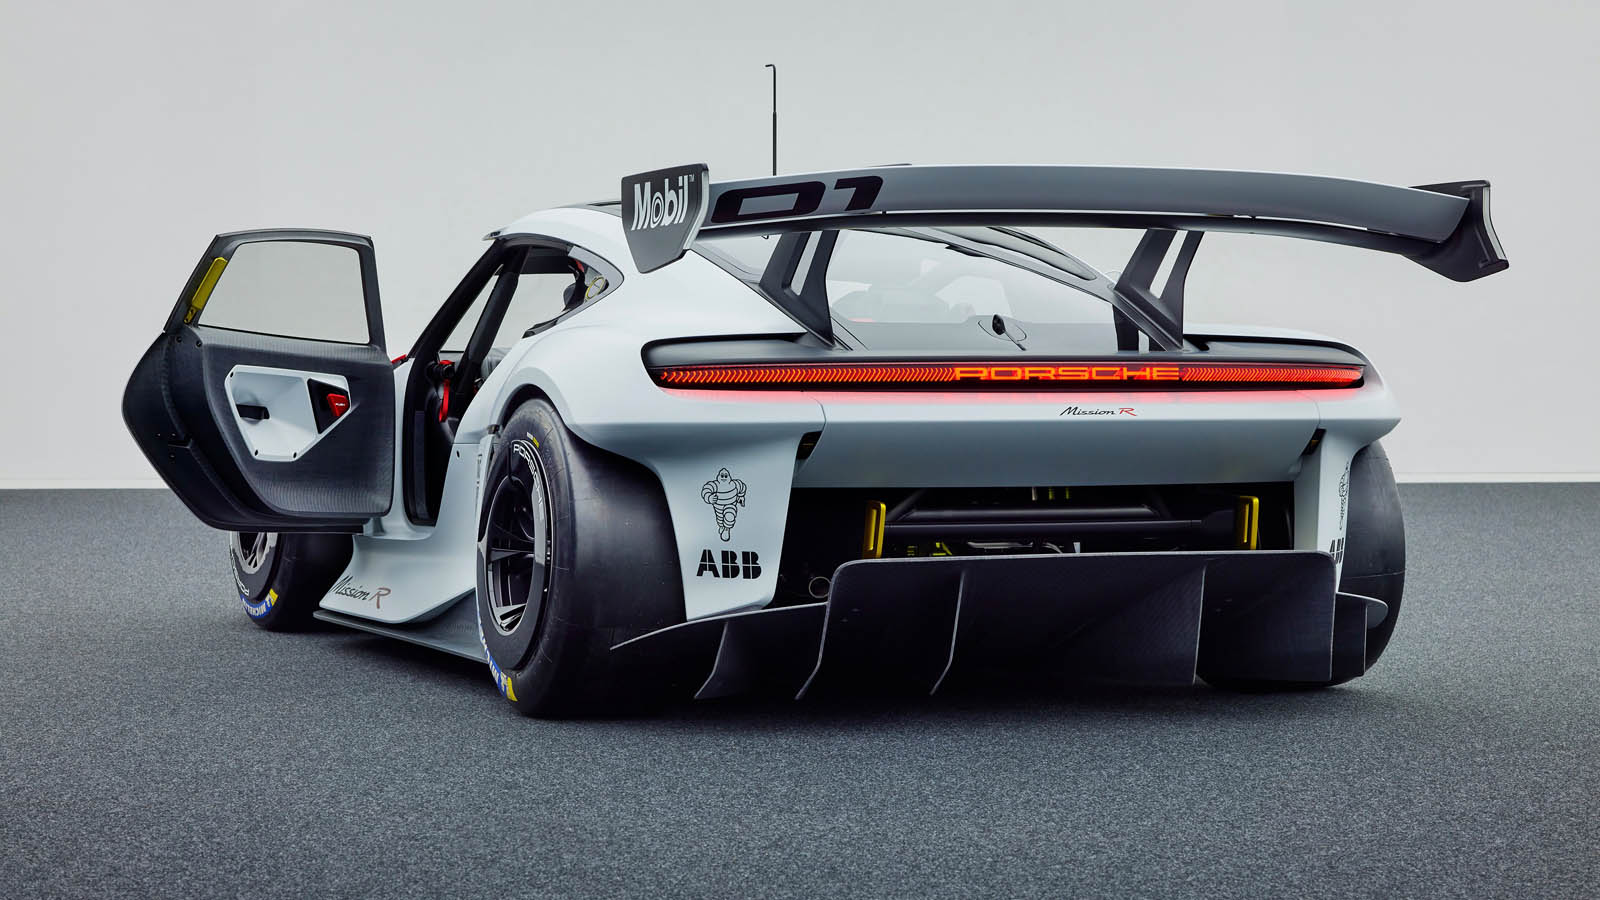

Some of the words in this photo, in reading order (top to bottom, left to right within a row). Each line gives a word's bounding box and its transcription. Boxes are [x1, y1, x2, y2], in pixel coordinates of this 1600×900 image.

[630, 174, 689, 232] Mobil
[711, 175, 884, 224] 01
[955, 366, 1180, 381] PORSCHE
[1059, 405, 1116, 417] Mission
[1118, 407, 1138, 417] R
[696, 548, 763, 580] ABB
[329, 574, 371, 601] Mission
[367, 586, 392, 609] R
